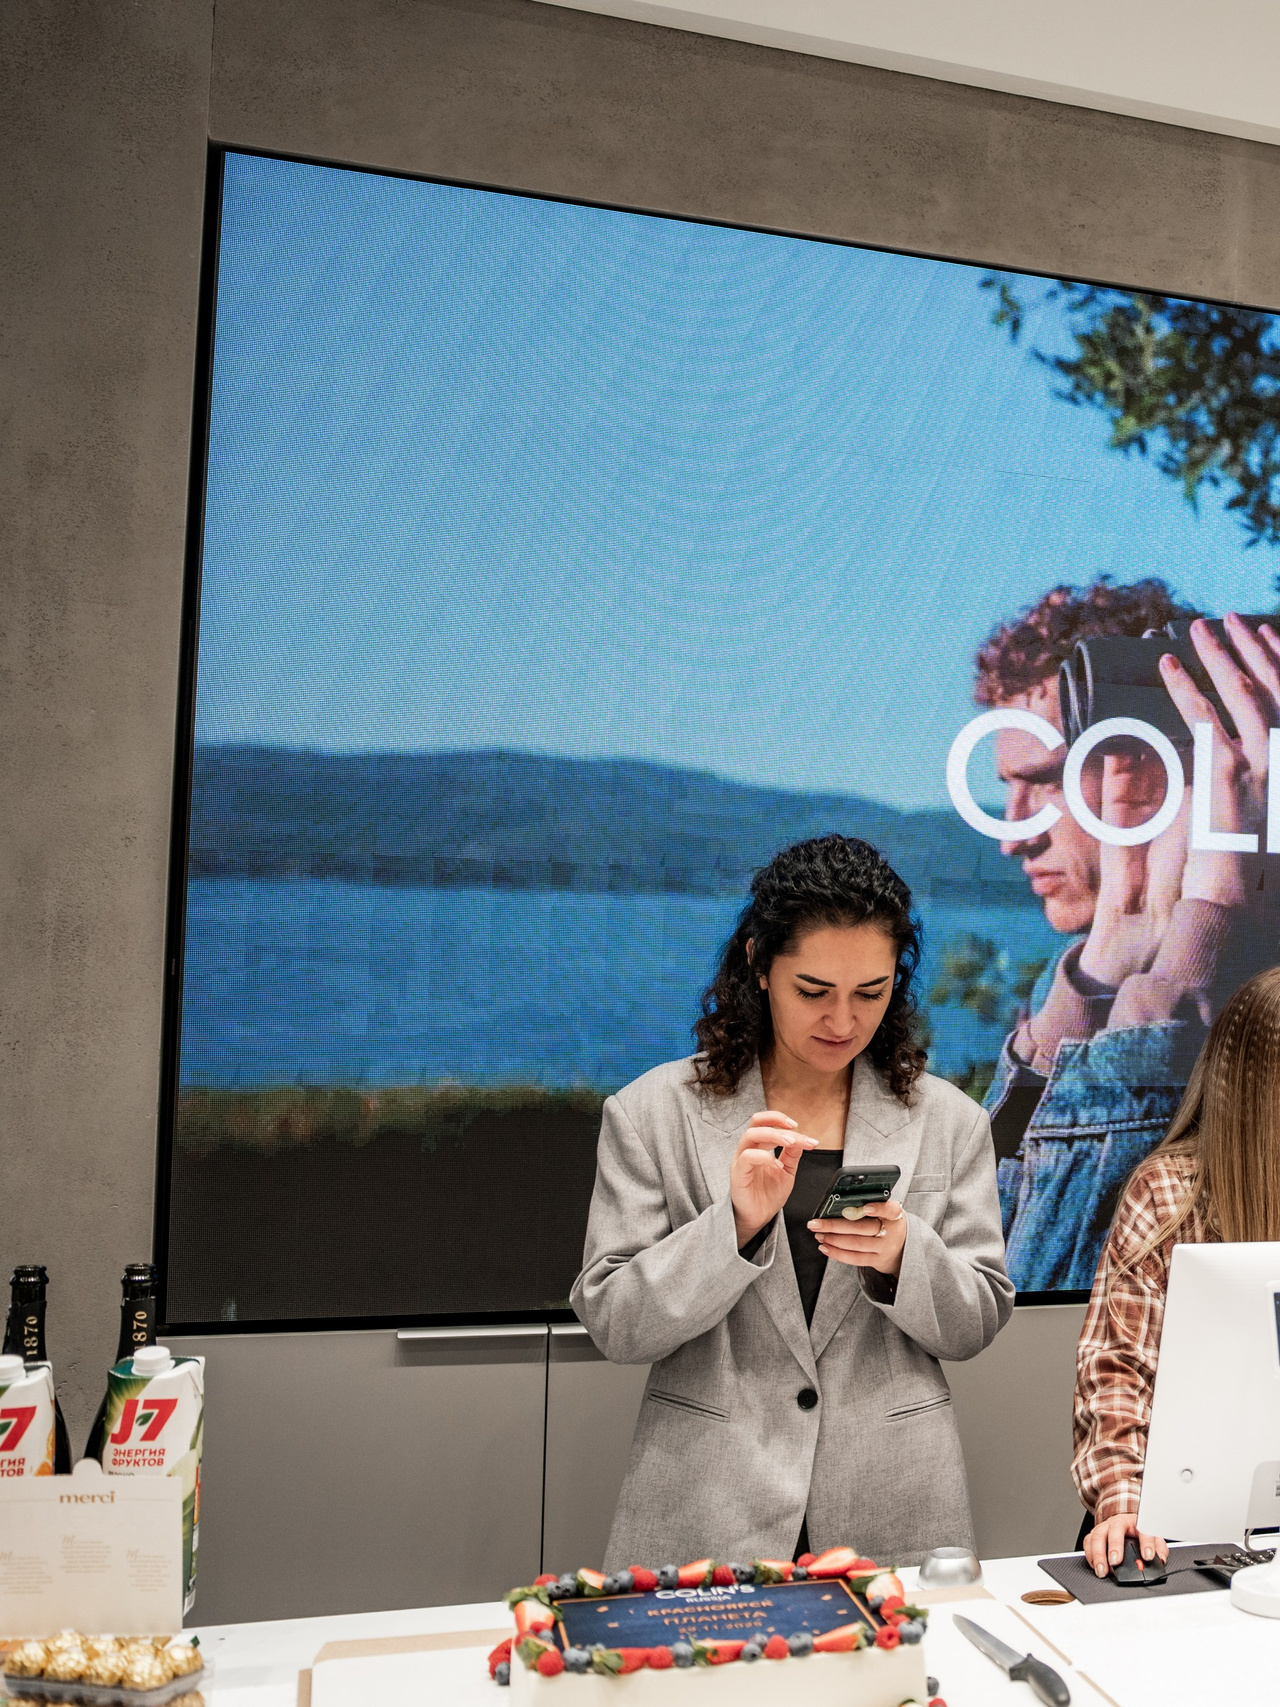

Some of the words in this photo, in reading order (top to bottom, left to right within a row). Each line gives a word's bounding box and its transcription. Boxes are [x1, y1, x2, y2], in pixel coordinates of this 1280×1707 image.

[23, 1315, 39, 1356] 1870
[110, 1398, 178, 1446] J7
[112, 1448, 166, 1458] ЭНЕРГИЯ
[111, 1458, 164, 1467] ФРУКТОВ
[59, 1490, 115, 1504] merci
[655, 1583, 756, 1600] COLIN'S
[664, 1610, 767, 1626] ПЛАНЕТА
